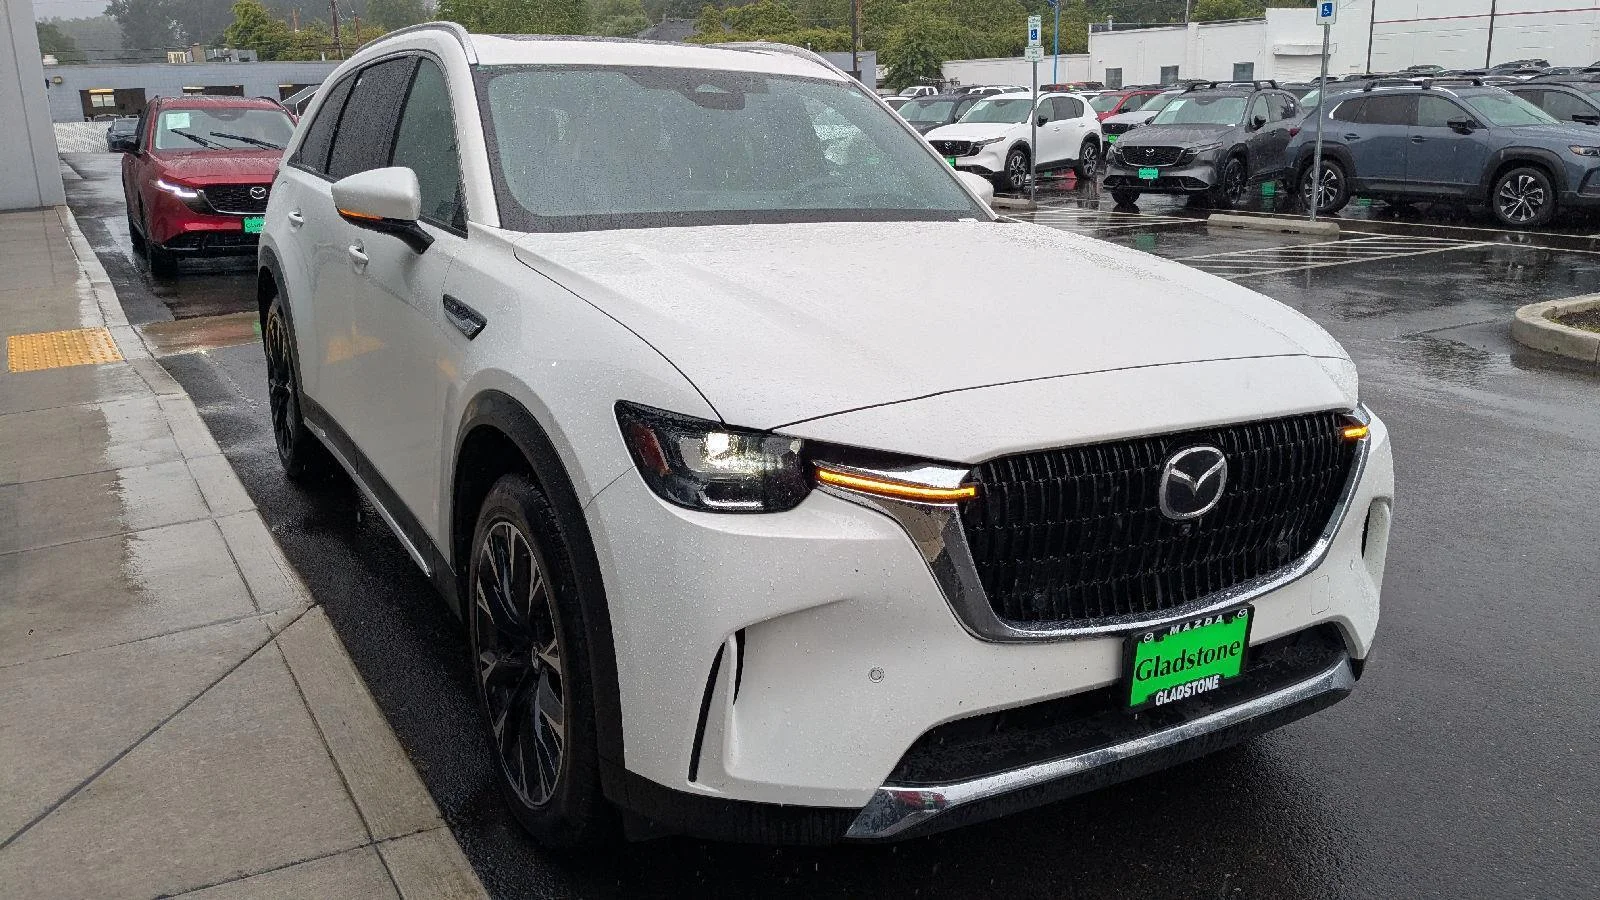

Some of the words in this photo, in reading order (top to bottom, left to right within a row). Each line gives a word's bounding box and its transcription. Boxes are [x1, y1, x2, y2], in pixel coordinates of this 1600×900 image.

[1169, 615, 1225, 635] MAZDA
[1135, 640, 1241, 681] Gladstone
[1155, 674, 1220, 706] GLADSTONE
